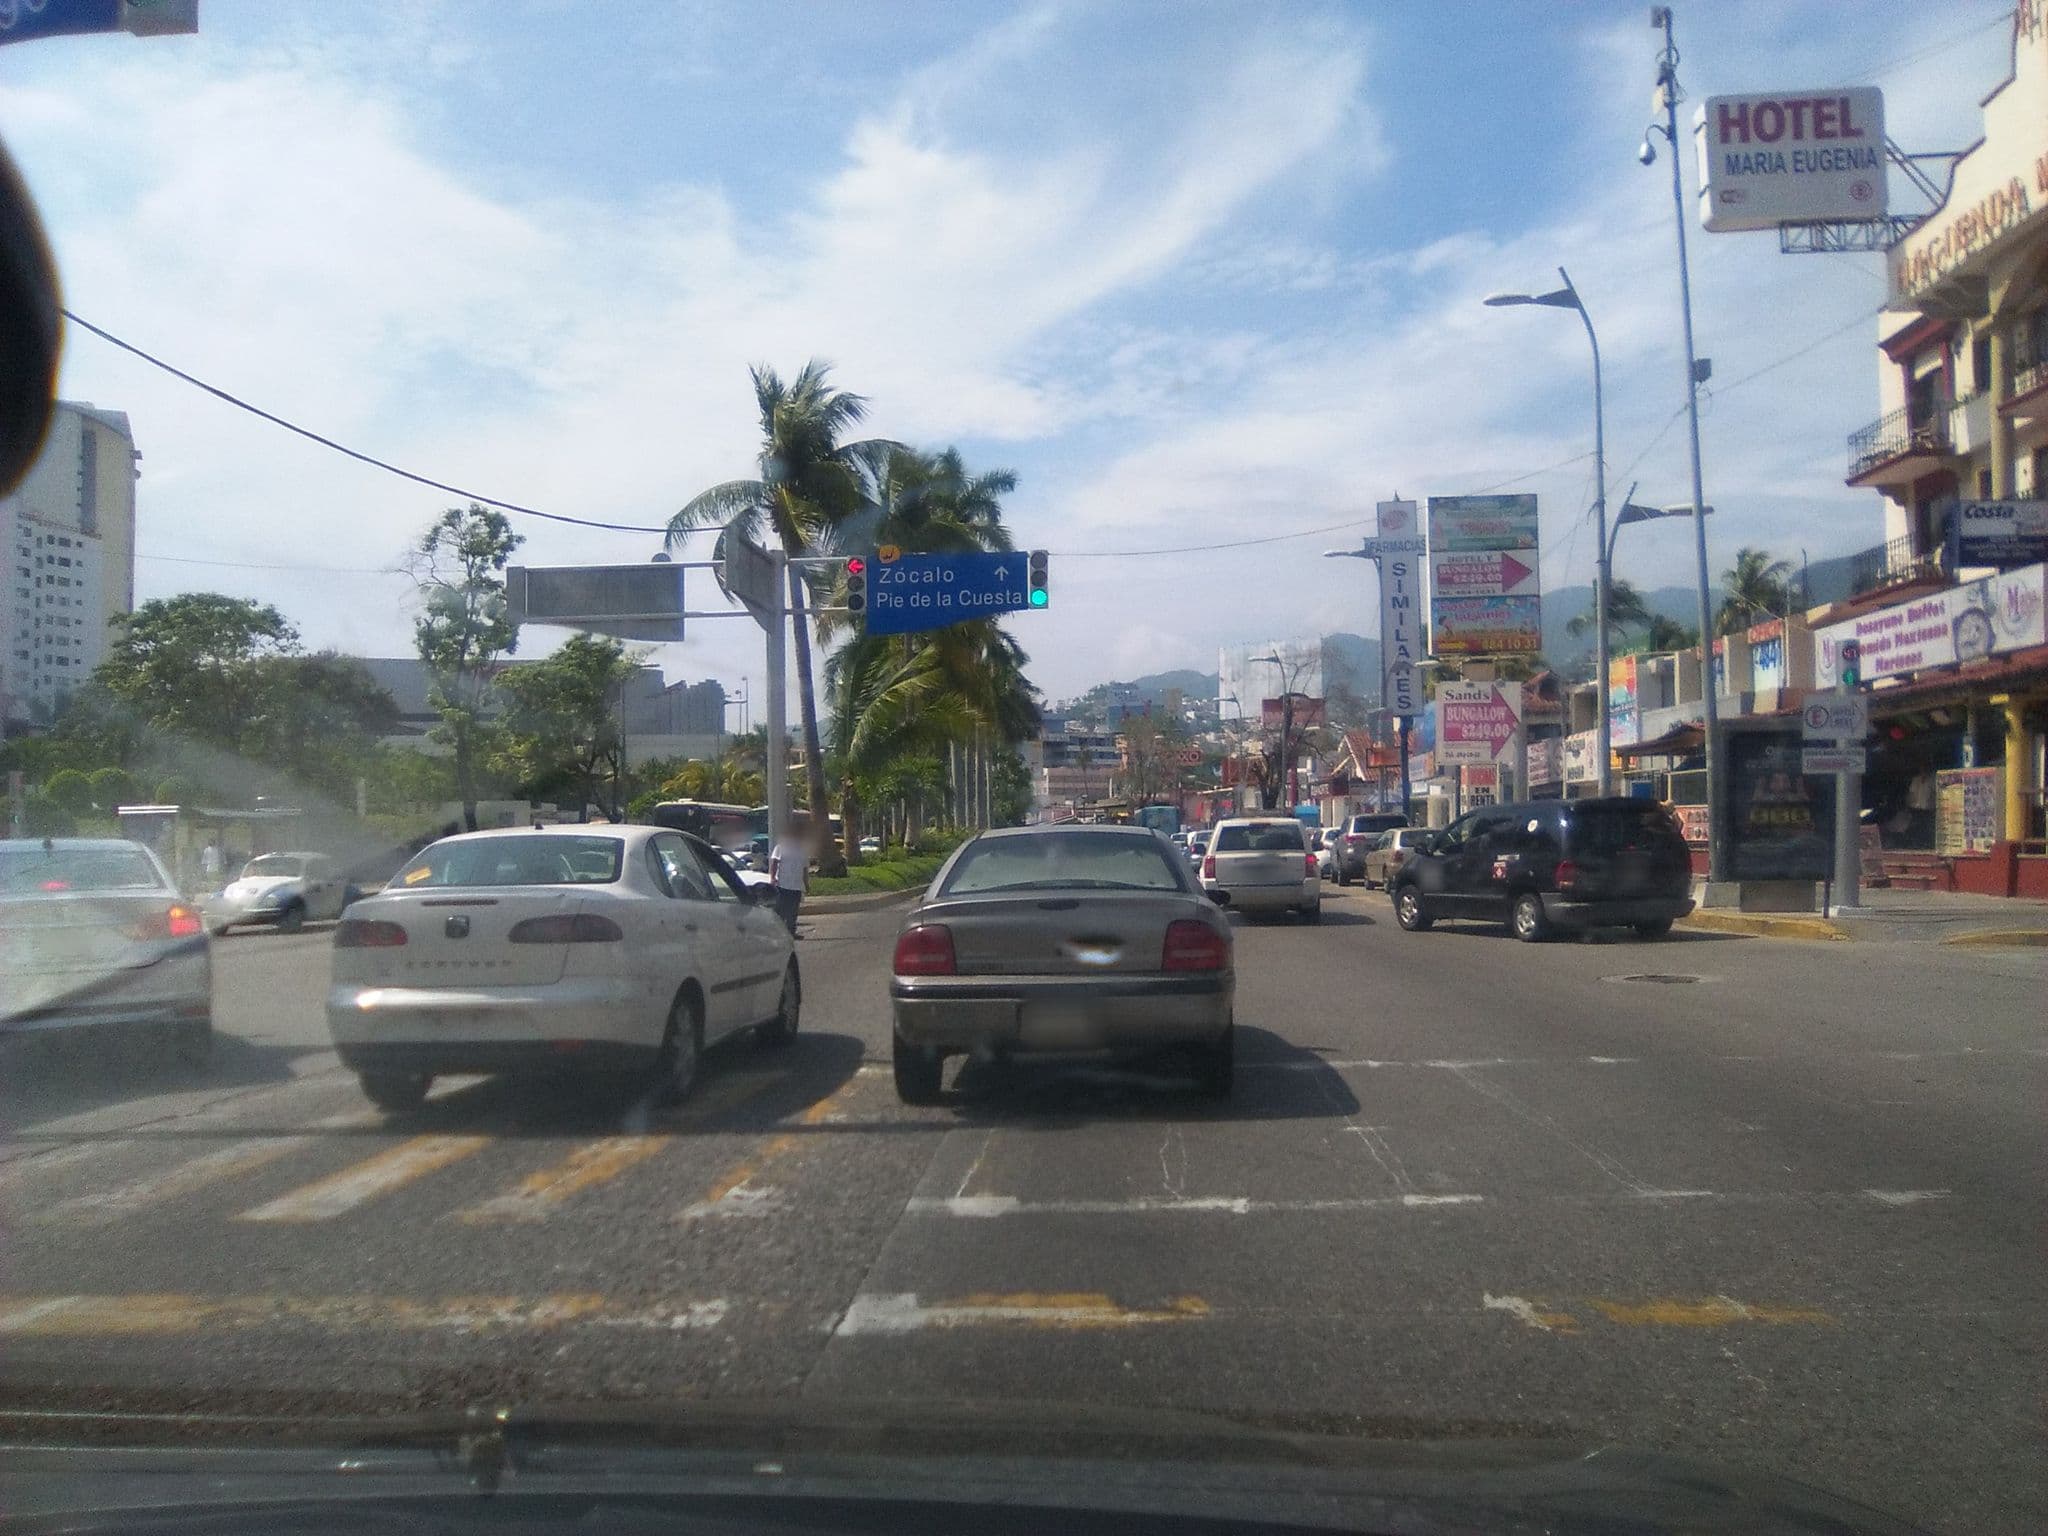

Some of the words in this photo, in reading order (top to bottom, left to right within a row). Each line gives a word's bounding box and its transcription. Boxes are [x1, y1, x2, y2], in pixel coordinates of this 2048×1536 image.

[1718, 97, 1865, 144] HOTEL
[1725, 152, 1788, 175] MARIA
[1793, 147, 1880, 173] EUGENIA
[879, 567, 954, 584] Zócalo
[1438, 564, 1501, 575] BUNGALOW
[877, 592, 904, 608] Pie
[910, 592, 931, 607] de
[937, 590, 952, 606] la
[959, 587, 1022, 605] Cuesta
[1859, 636, 1891, 656] omida
[1445, 689, 1490, 701] Sands
[1447, 706, 1506, 722] BUNGALOW
[1461, 723, 1510, 739] $249.00
